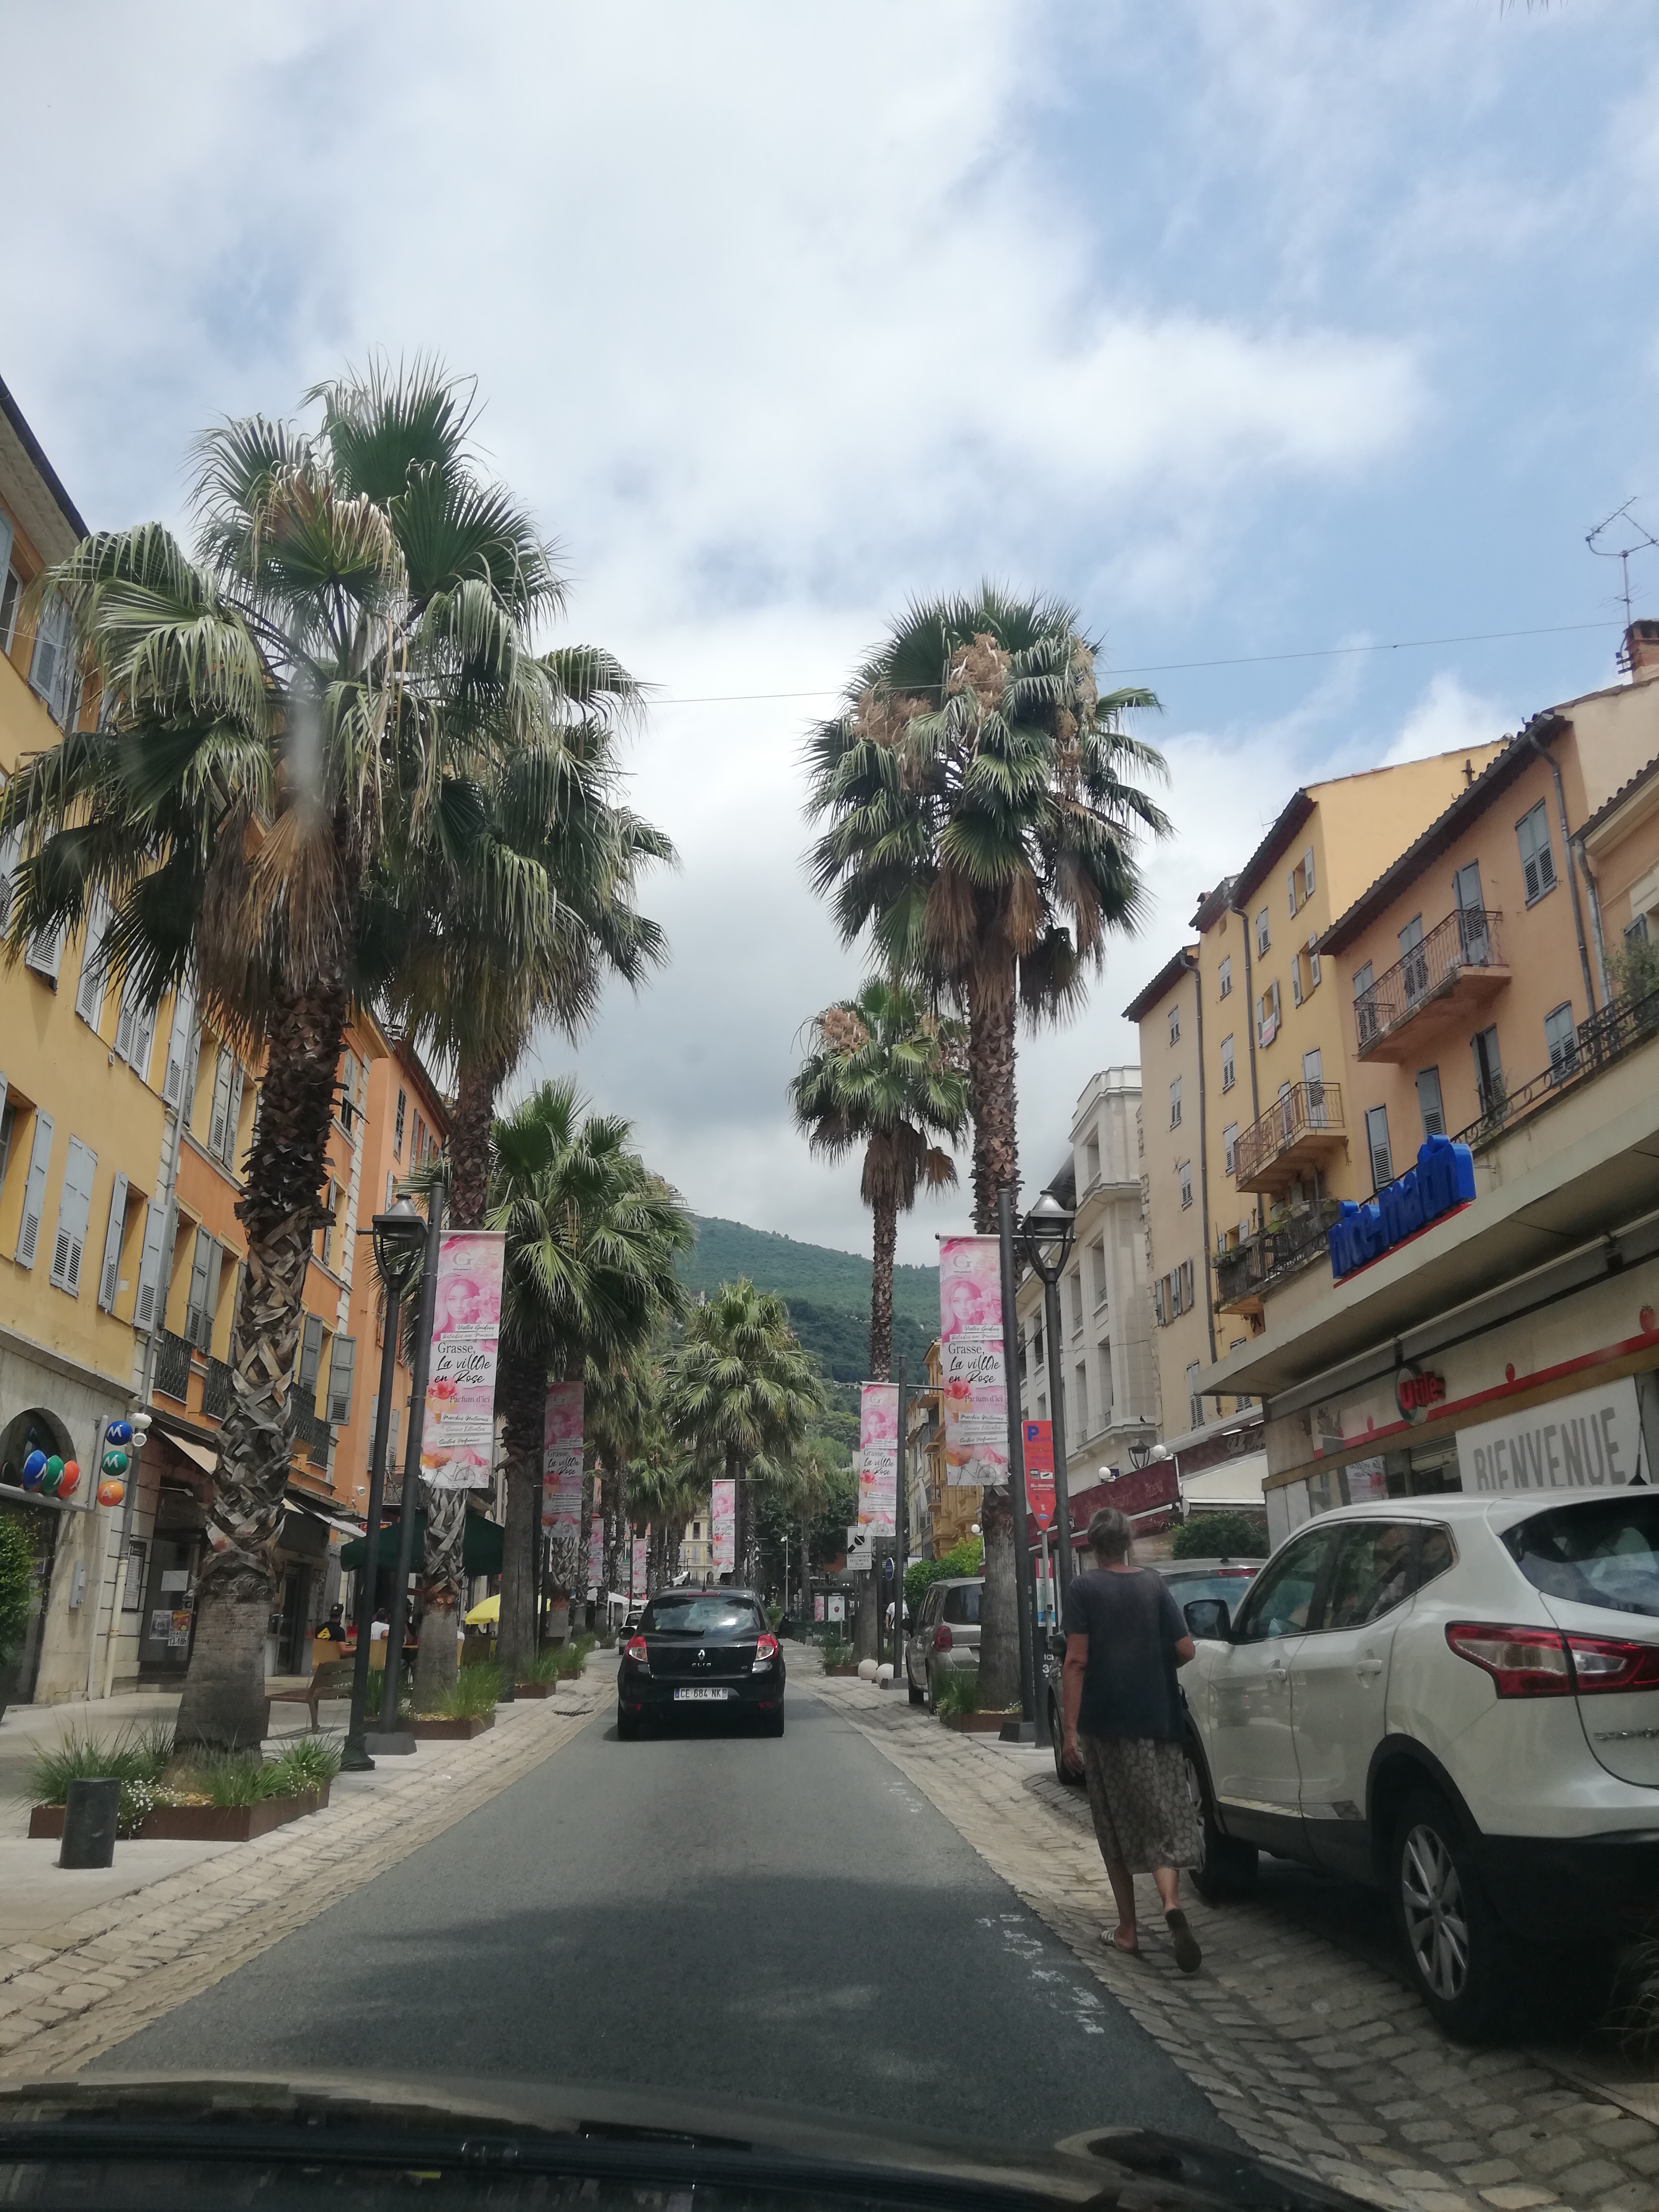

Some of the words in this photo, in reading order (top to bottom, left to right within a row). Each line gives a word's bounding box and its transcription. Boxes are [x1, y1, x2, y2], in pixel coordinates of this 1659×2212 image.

[438, 1342, 476, 1355] Grasse,
[948, 1343, 985, 1355] Grasse,
[436, 1355, 453, 1371] La
[949, 1356, 964, 1371] La
[453, 1370, 485, 1383] Rose
[966, 1370, 996, 1383] Rose
[1474, 1407, 1626, 1491] BIENVENUE
[864, 1457, 873, 1467] La
[873, 1466, 891, 1475] Rose
[681, 1689, 721, 1698] CE-684-NK
